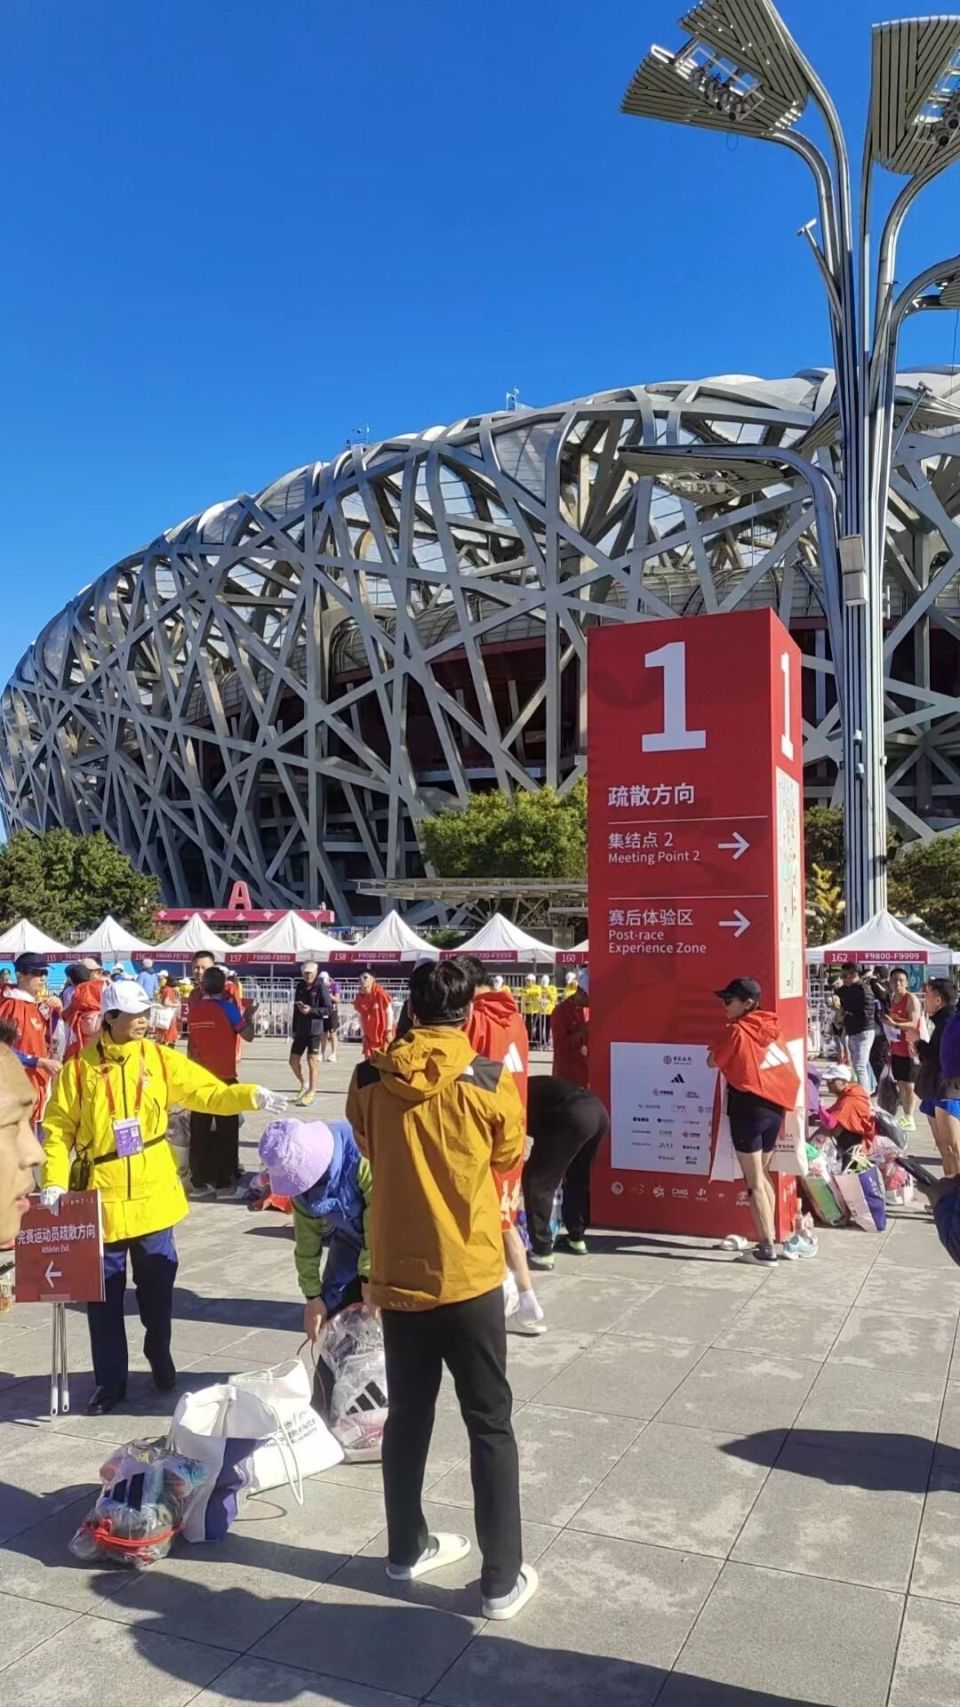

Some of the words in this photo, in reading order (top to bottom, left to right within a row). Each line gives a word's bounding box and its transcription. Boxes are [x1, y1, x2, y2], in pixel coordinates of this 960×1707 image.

[642, 641, 706, 753] 1
[781, 651, 794, 762] 1
[607, 782, 695, 807] 疏散方向
[608, 831, 658, 849] 集结点
[664, 832, 673, 847] 2
[608, 852, 655, 866] Meeting
[658, 851, 690, 862] Point
[693, 850, 701, 861] 2
[228, 880, 253, 910] A
[608, 908, 695, 926] 赛后体验区
[608, 929, 665, 941] Post-race
[334, 953, 347, 961] 158
[608, 942, 674, 956] Experience
[676, 942, 708, 954] Zone
[831, 953, 848, 963] 162
[865, 952, 920, 960] F9800-F9999
[230, 954, 243, 963] 157
[561, 953, 576, 963] 160
[18, 1223, 96, 1245] 完赛运动员疏散方向
